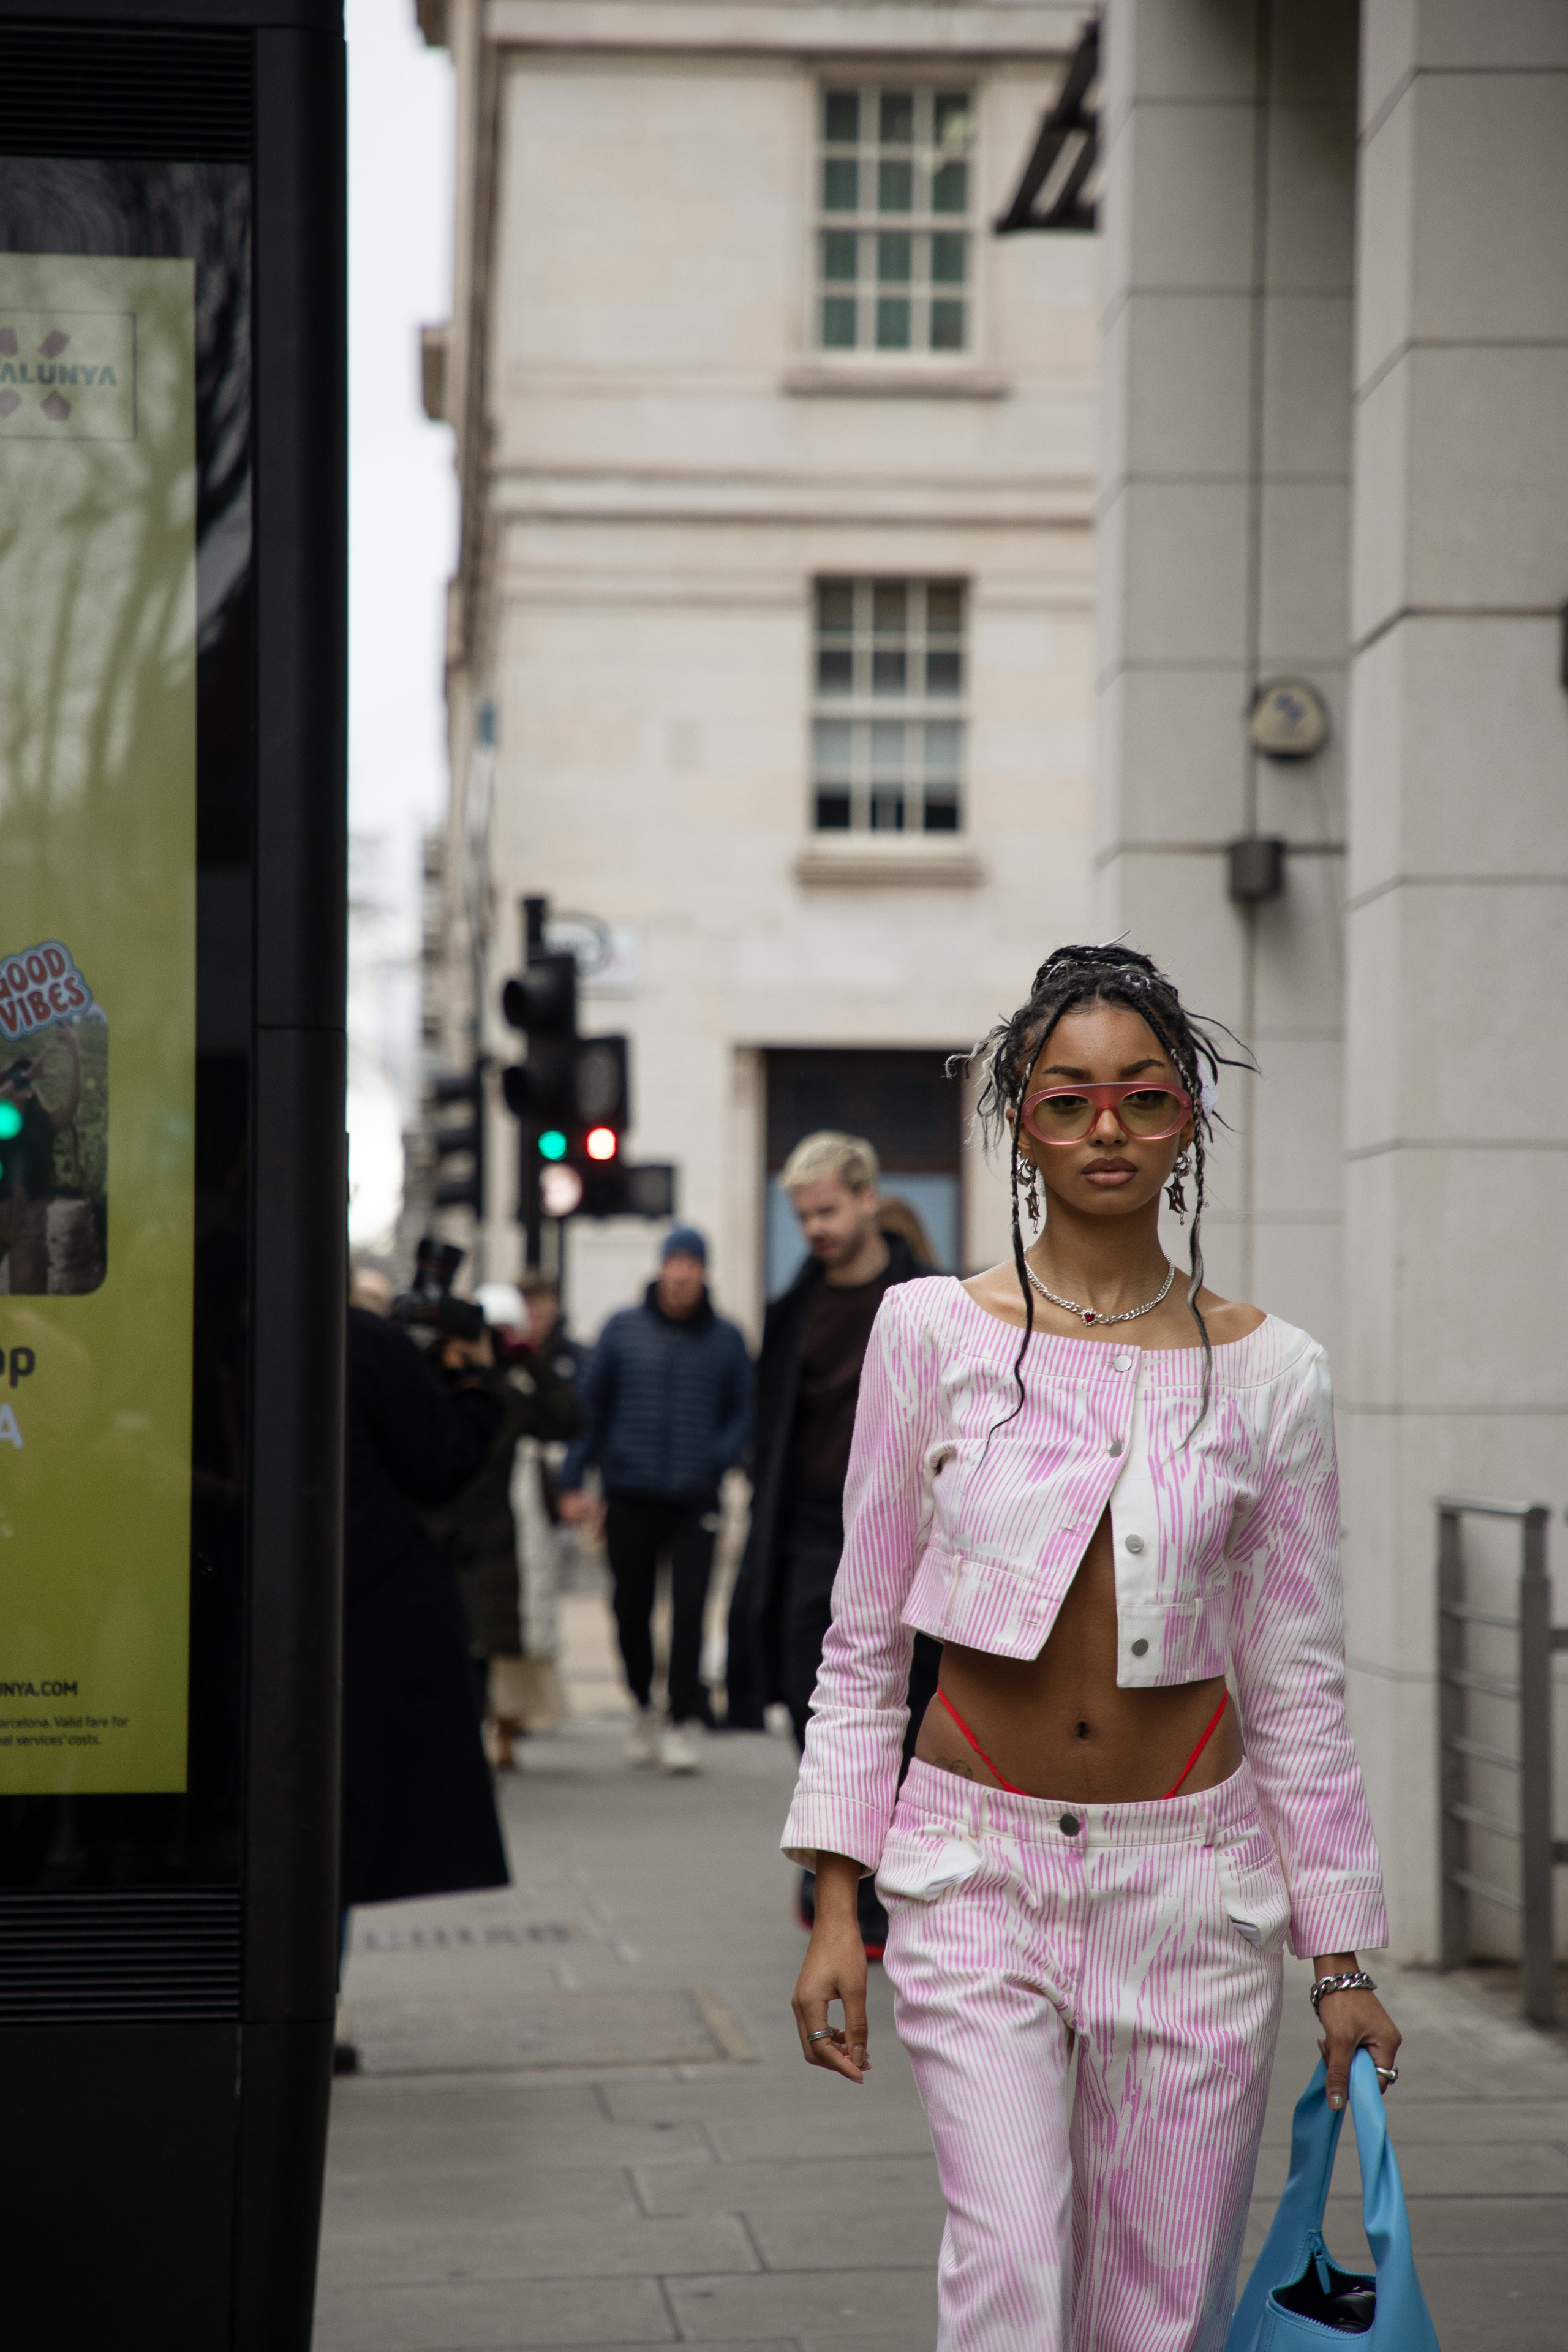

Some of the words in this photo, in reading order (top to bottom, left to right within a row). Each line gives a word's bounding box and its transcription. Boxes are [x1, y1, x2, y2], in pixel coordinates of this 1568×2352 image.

[0, 363, 116, 386] ALUNYA
[0, 977, 84, 1031] VIBES
[0, 1346, 36, 1389] p
[54, 1716, 83, 1728] Valid
[112, 1716, 129, 1728] for
